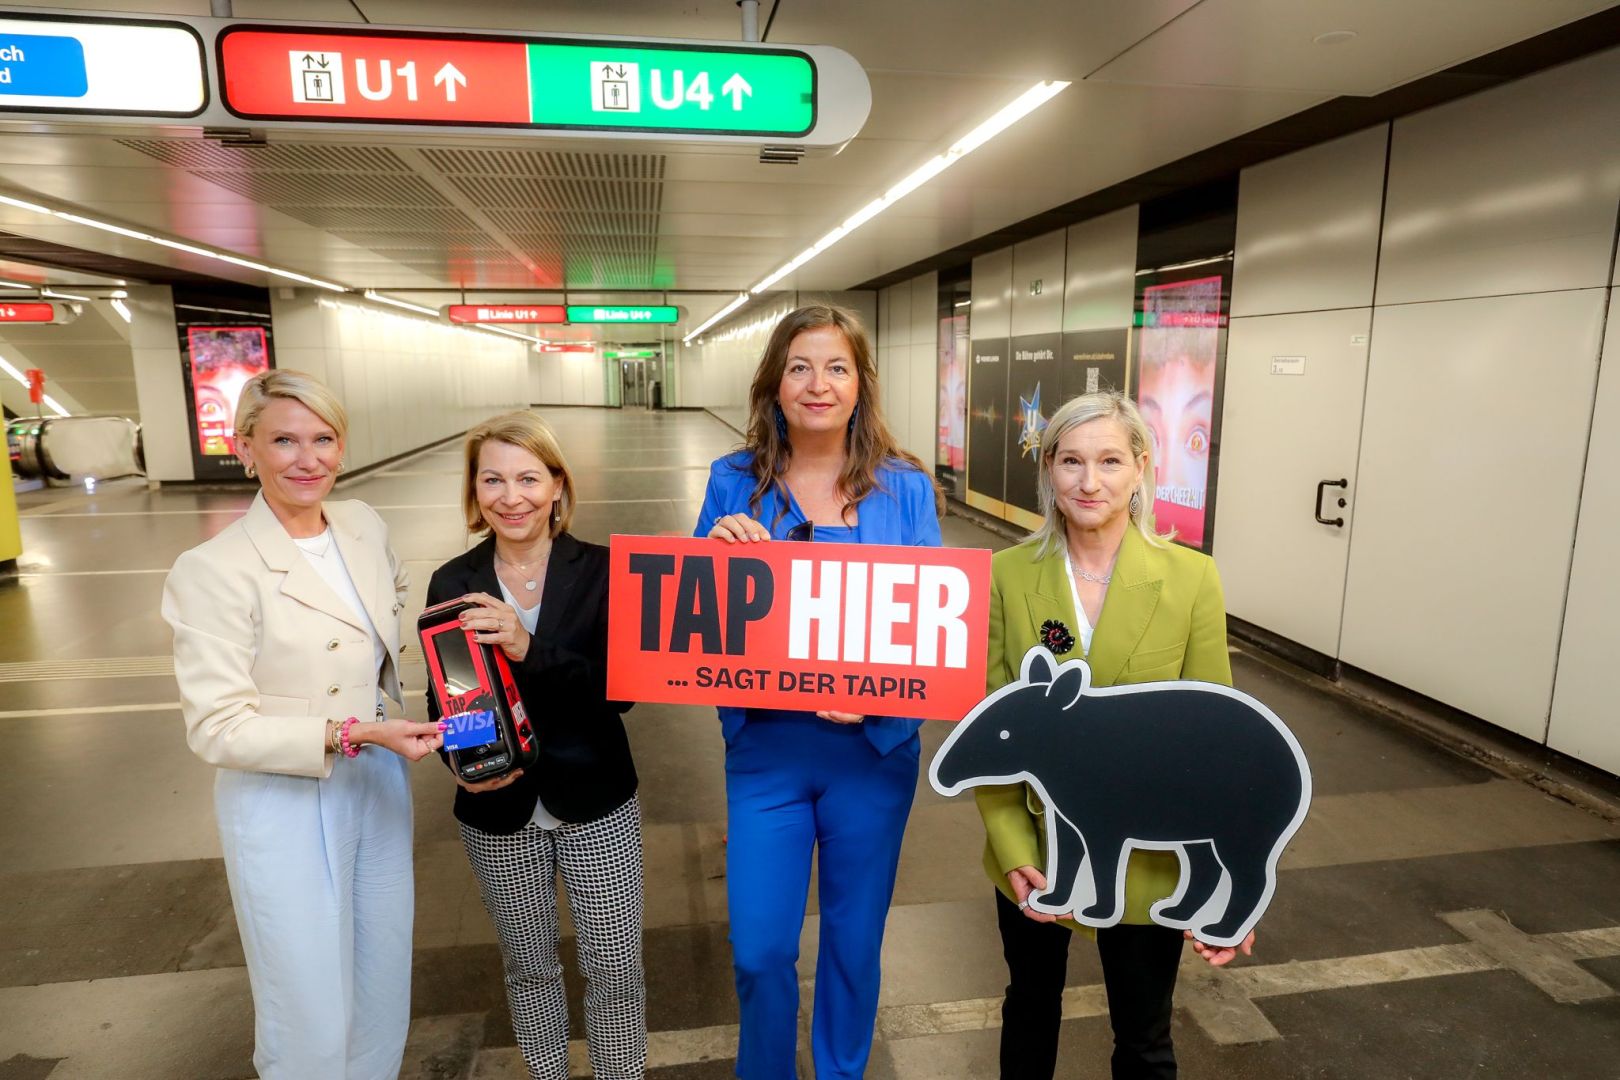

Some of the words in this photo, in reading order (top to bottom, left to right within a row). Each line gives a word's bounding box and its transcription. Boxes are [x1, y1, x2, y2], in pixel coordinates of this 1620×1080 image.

[355, 58, 418, 102] U1
[650, 68, 714, 111] U4
[490, 309, 513, 319] Linie
[515, 309, 528, 319] U1
[1027, 408, 1037, 432] U
[629, 552, 775, 656] TAP
[788, 559, 970, 669] HIER
[695, 666, 771, 691] SAGT
[778, 670, 835, 695] DER
[843, 673, 926, 700] TAPIR
[446, 697, 465, 717] TAP
